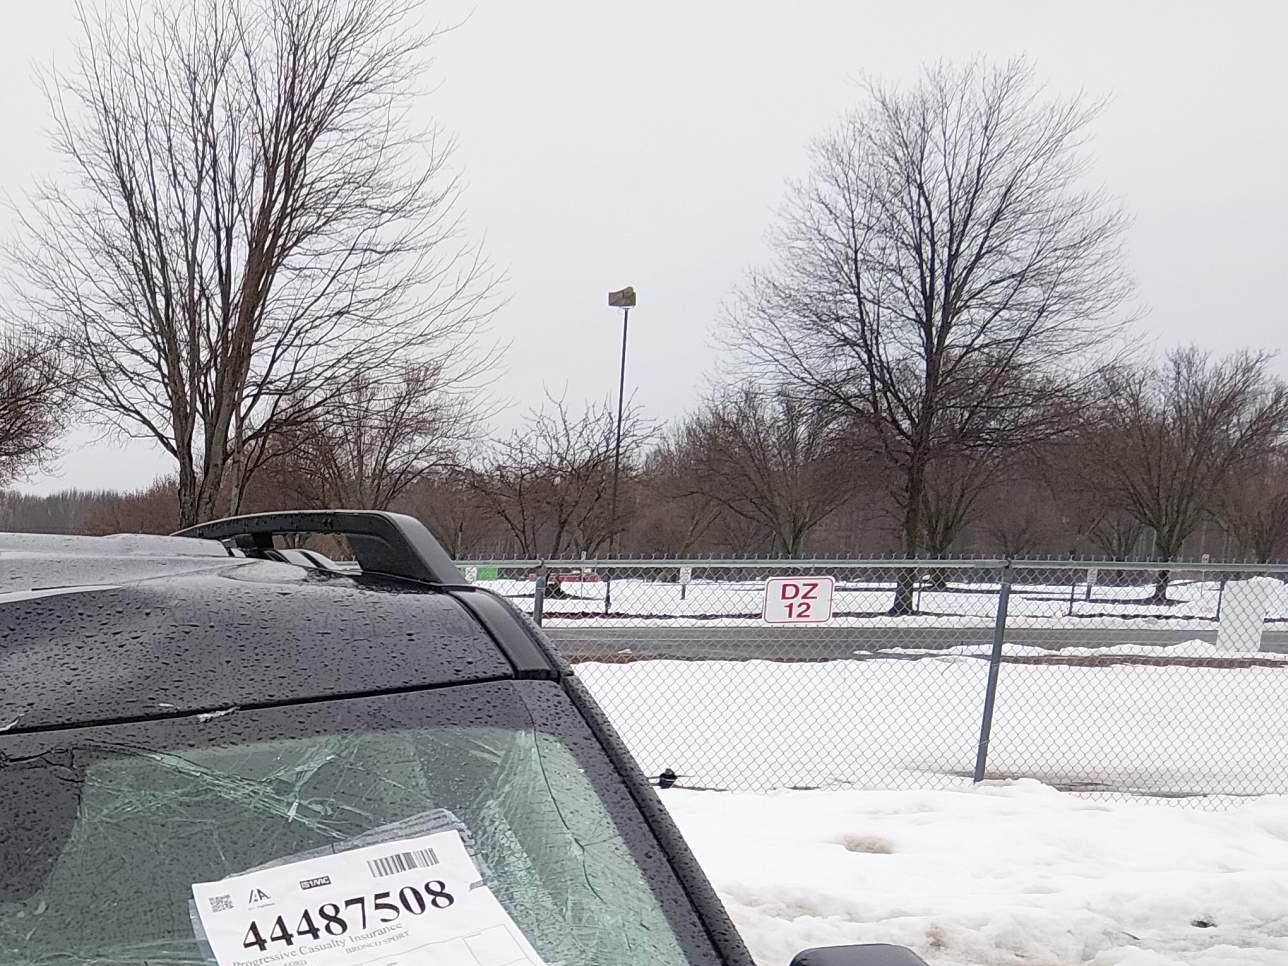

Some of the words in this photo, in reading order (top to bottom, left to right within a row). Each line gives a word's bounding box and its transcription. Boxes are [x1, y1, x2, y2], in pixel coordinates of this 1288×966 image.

[781, 583, 819, 600] DZ
[784, 602, 811, 618] 12
[243, 880, 455, 951] 44487508
[298, 937, 346, 956] Casualty
[349, 923, 402, 943] Insurance
[383, 930, 410, 945] SPORT
